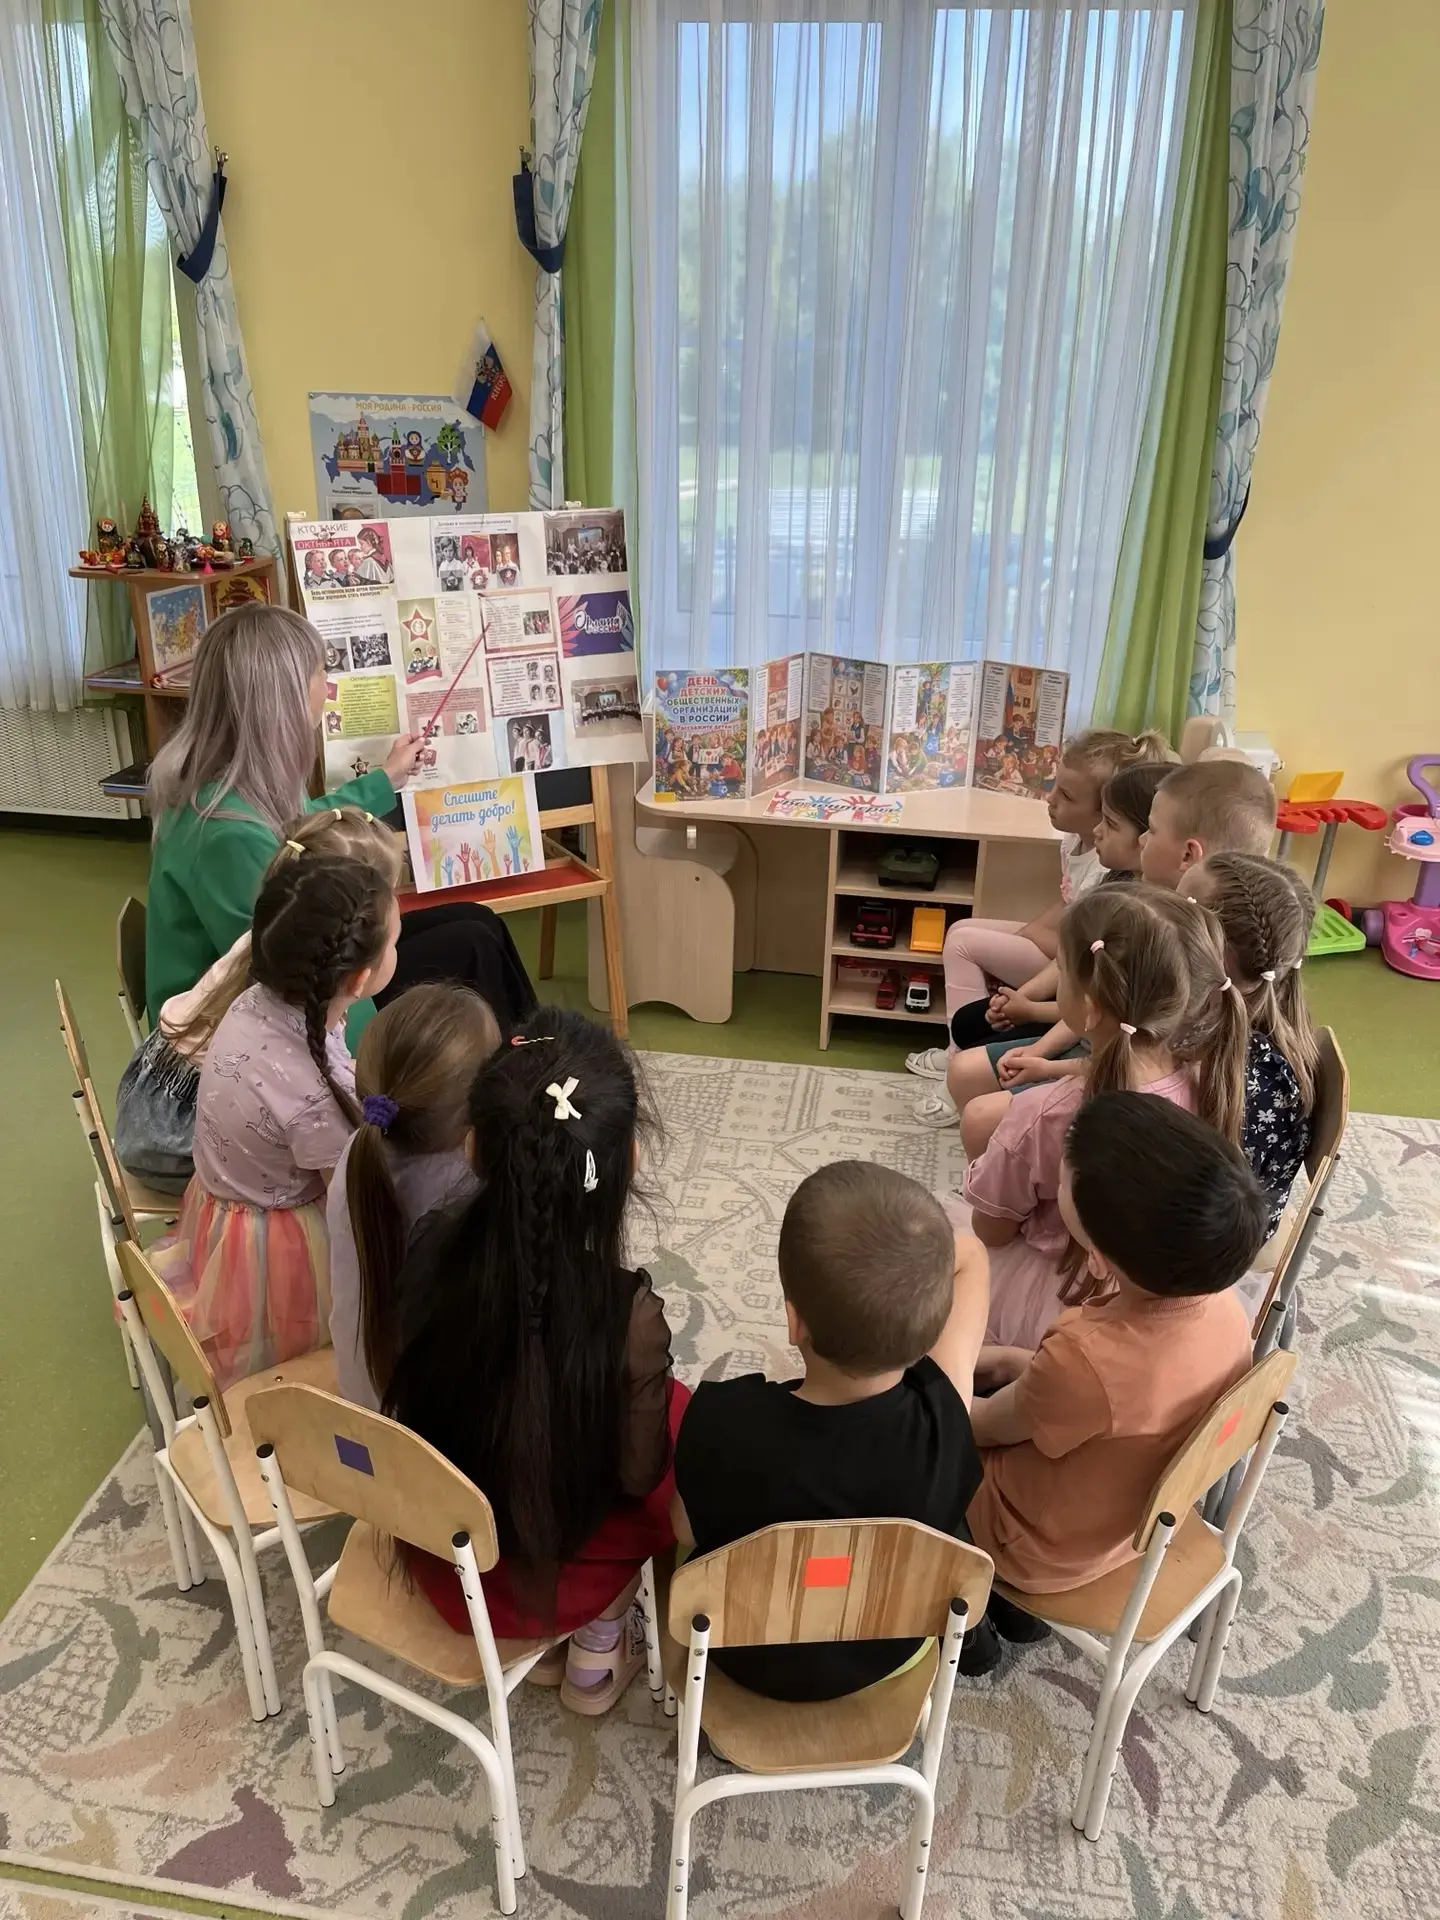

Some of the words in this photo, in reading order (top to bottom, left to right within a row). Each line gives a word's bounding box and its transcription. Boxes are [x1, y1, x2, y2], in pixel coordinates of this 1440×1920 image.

[356, 402, 373, 410] МОЯ
[374, 403, 406, 412] РОДИНА
[412, 404, 442, 412] РОССИЯ
[298, 525, 316, 534] КТО
[319, 523, 348, 533] ТАКИЕ
[687, 676, 718, 687] ДЕНЬ
[680, 688, 726, 697] ДЕТСКИХ
[667, 697, 739, 706] ОБЩЕСТВЕННЫХ
[673, 705, 738, 715] ОРГАНИЗАЦИЙ
[680, 715, 686, 723] В
[689, 714, 729, 723] РОССИИ
[444, 789, 498, 806] Спешите
[431, 810, 476, 833] делать
[479, 799, 515, 826] добро!
